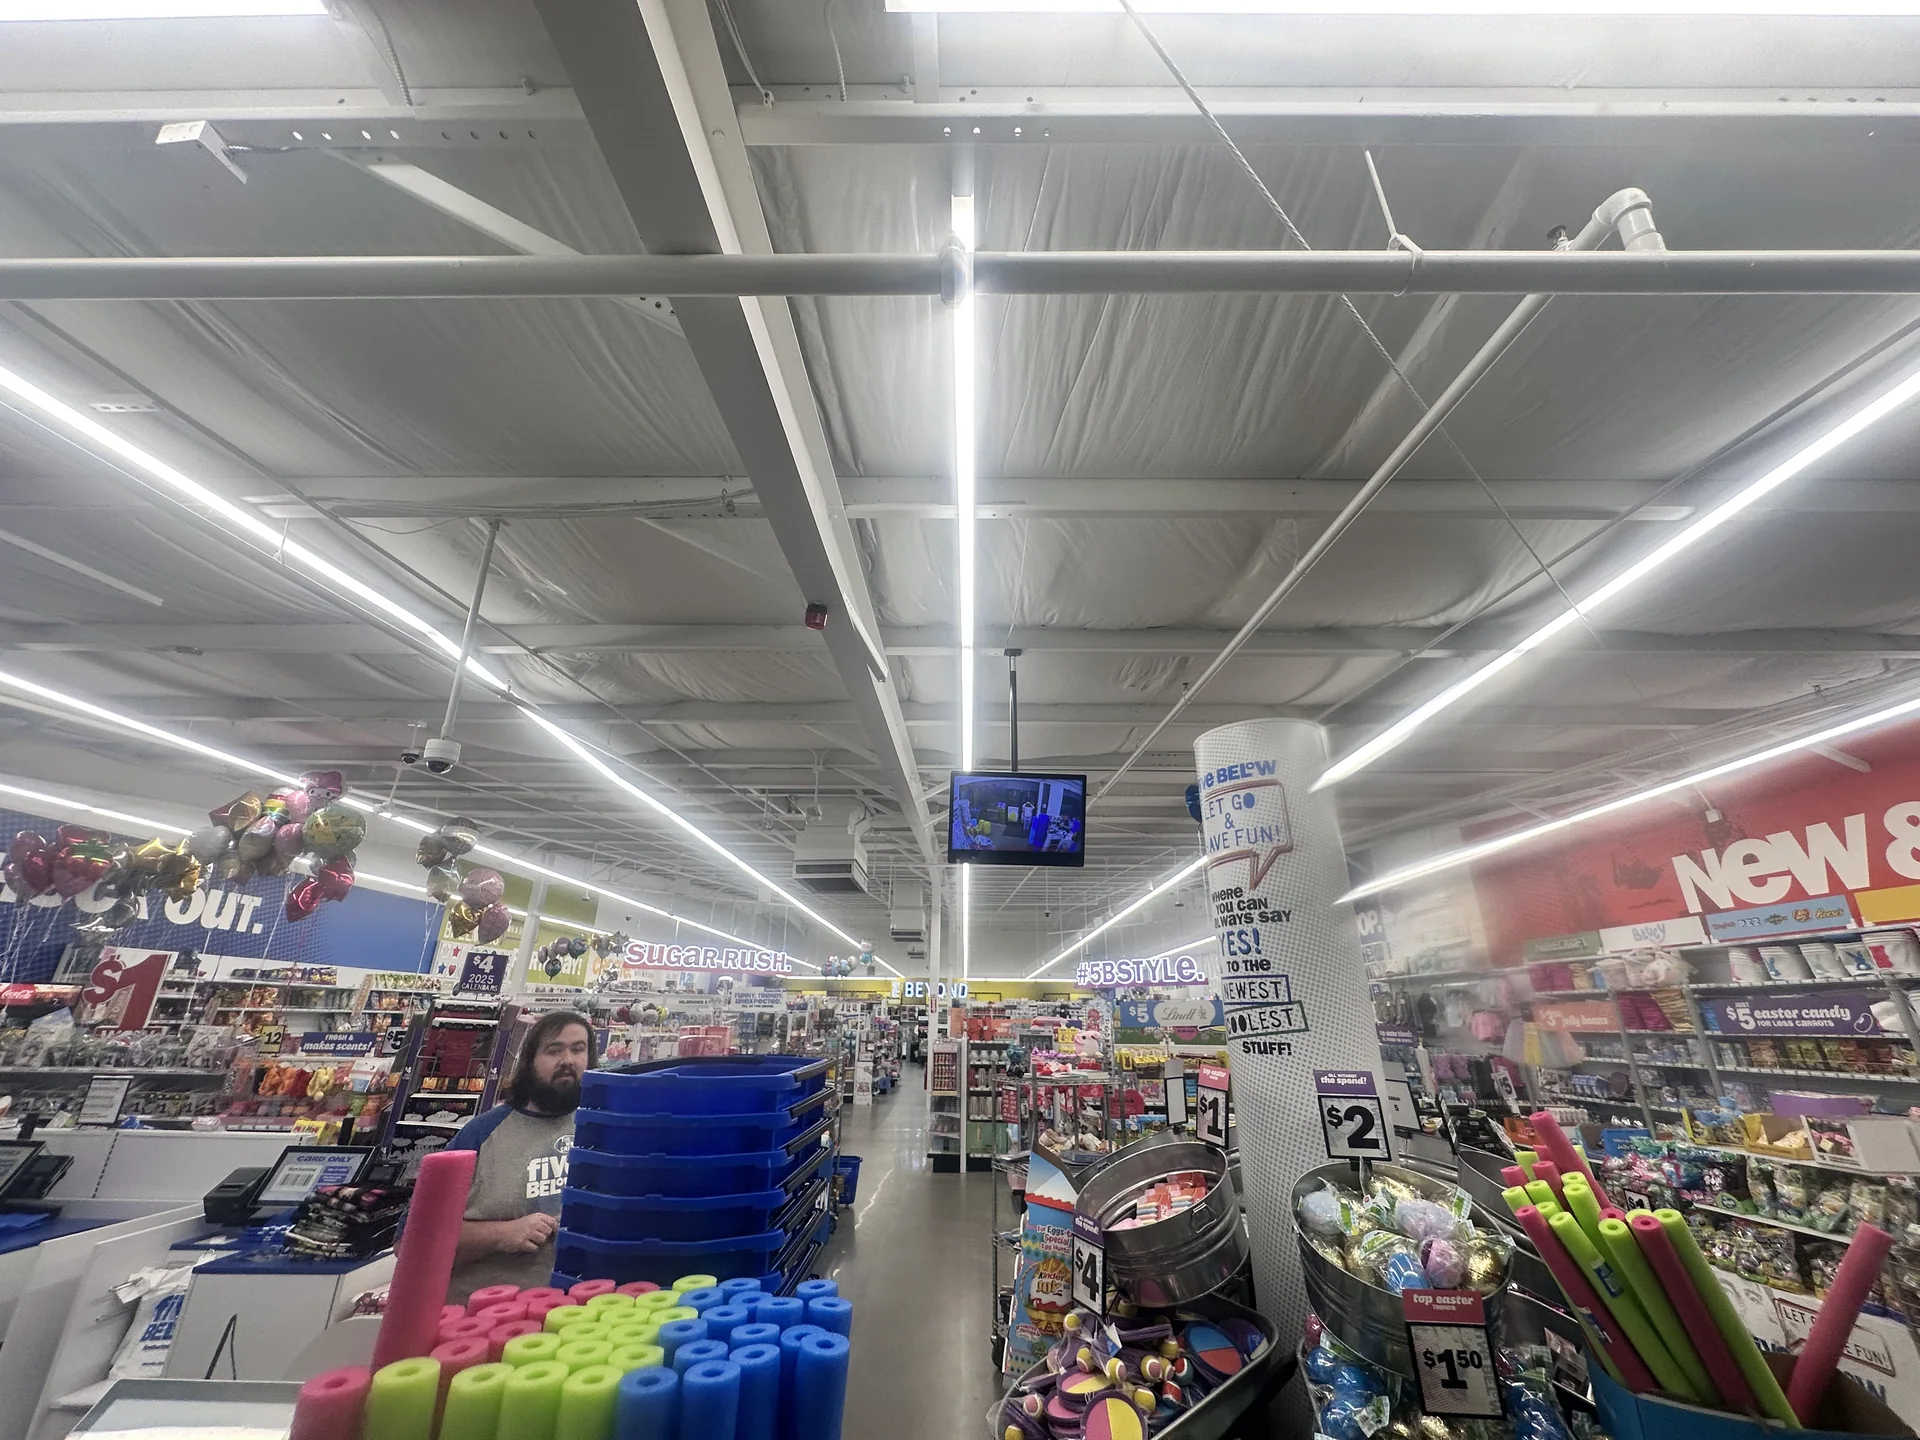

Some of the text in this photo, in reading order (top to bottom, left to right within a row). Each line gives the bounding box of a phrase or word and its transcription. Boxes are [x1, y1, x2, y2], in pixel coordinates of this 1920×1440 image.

[1216, 760, 1276, 784] BELOW
[1225, 813, 1235, 829] &
[1209, 825, 1280, 853] AVE FUN!
[1218, 928, 1261, 956] YES!
[472, 955, 494, 973] $4
[467, 973, 494, 984] 2025
[83, 953, 171, 1030] $1
[1128, 1006, 1149, 1023] $5
[1161, 1007, 1197, 1020] Lindt
[1726, 1005, 1851, 1030] $5 easter candy
[303, 1041, 372, 1051] makes scents!
[386, 1030, 406, 1050] $5
[1321, 1076, 1367, 1086] the spend!
[1199, 1094, 1223, 1138] $1
[1326, 1104, 1381, 1150] $2
[526, 1177, 568, 1198] BELO
[1041, 1242, 1052, 1251] Egg
[1045, 1234, 1070, 1248] Special
[1075, 1247, 1099, 1303] $4
[1413, 1294, 1474, 1305] top easter
[1783, 1307, 1806, 1324] LET
[1854, 1344, 1891, 1368] FUN!
